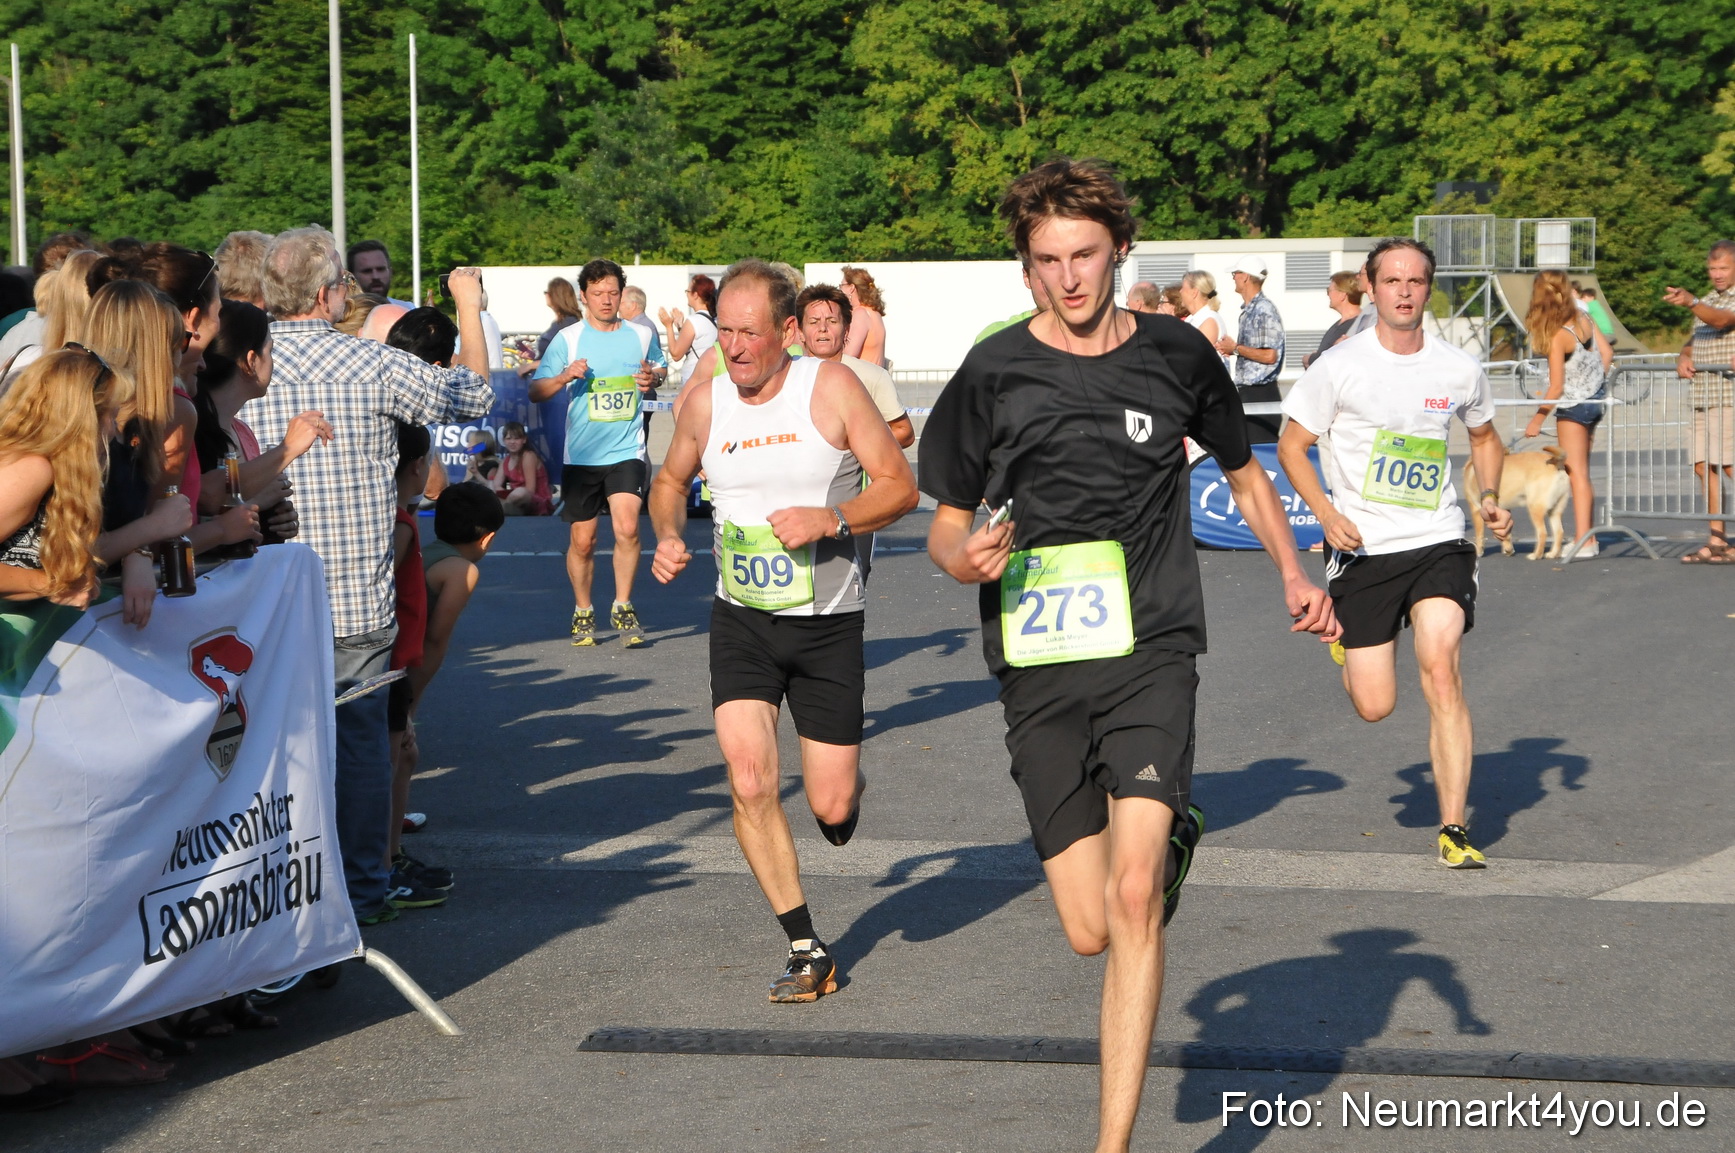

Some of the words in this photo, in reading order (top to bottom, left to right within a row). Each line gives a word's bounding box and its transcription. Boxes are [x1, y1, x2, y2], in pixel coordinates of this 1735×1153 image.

[590, 391, 634, 411] 1387
[742, 433, 803, 450] KLEBL
[1372, 456, 1440, 491] 1063
[733, 554, 794, 588] 509
[1019, 584, 1108, 635] 273
[1045, 635, 1066, 643] Lukas
[1135, 774, 1160, 783] adidas
[138, 841, 321, 966] Lammsbräu
